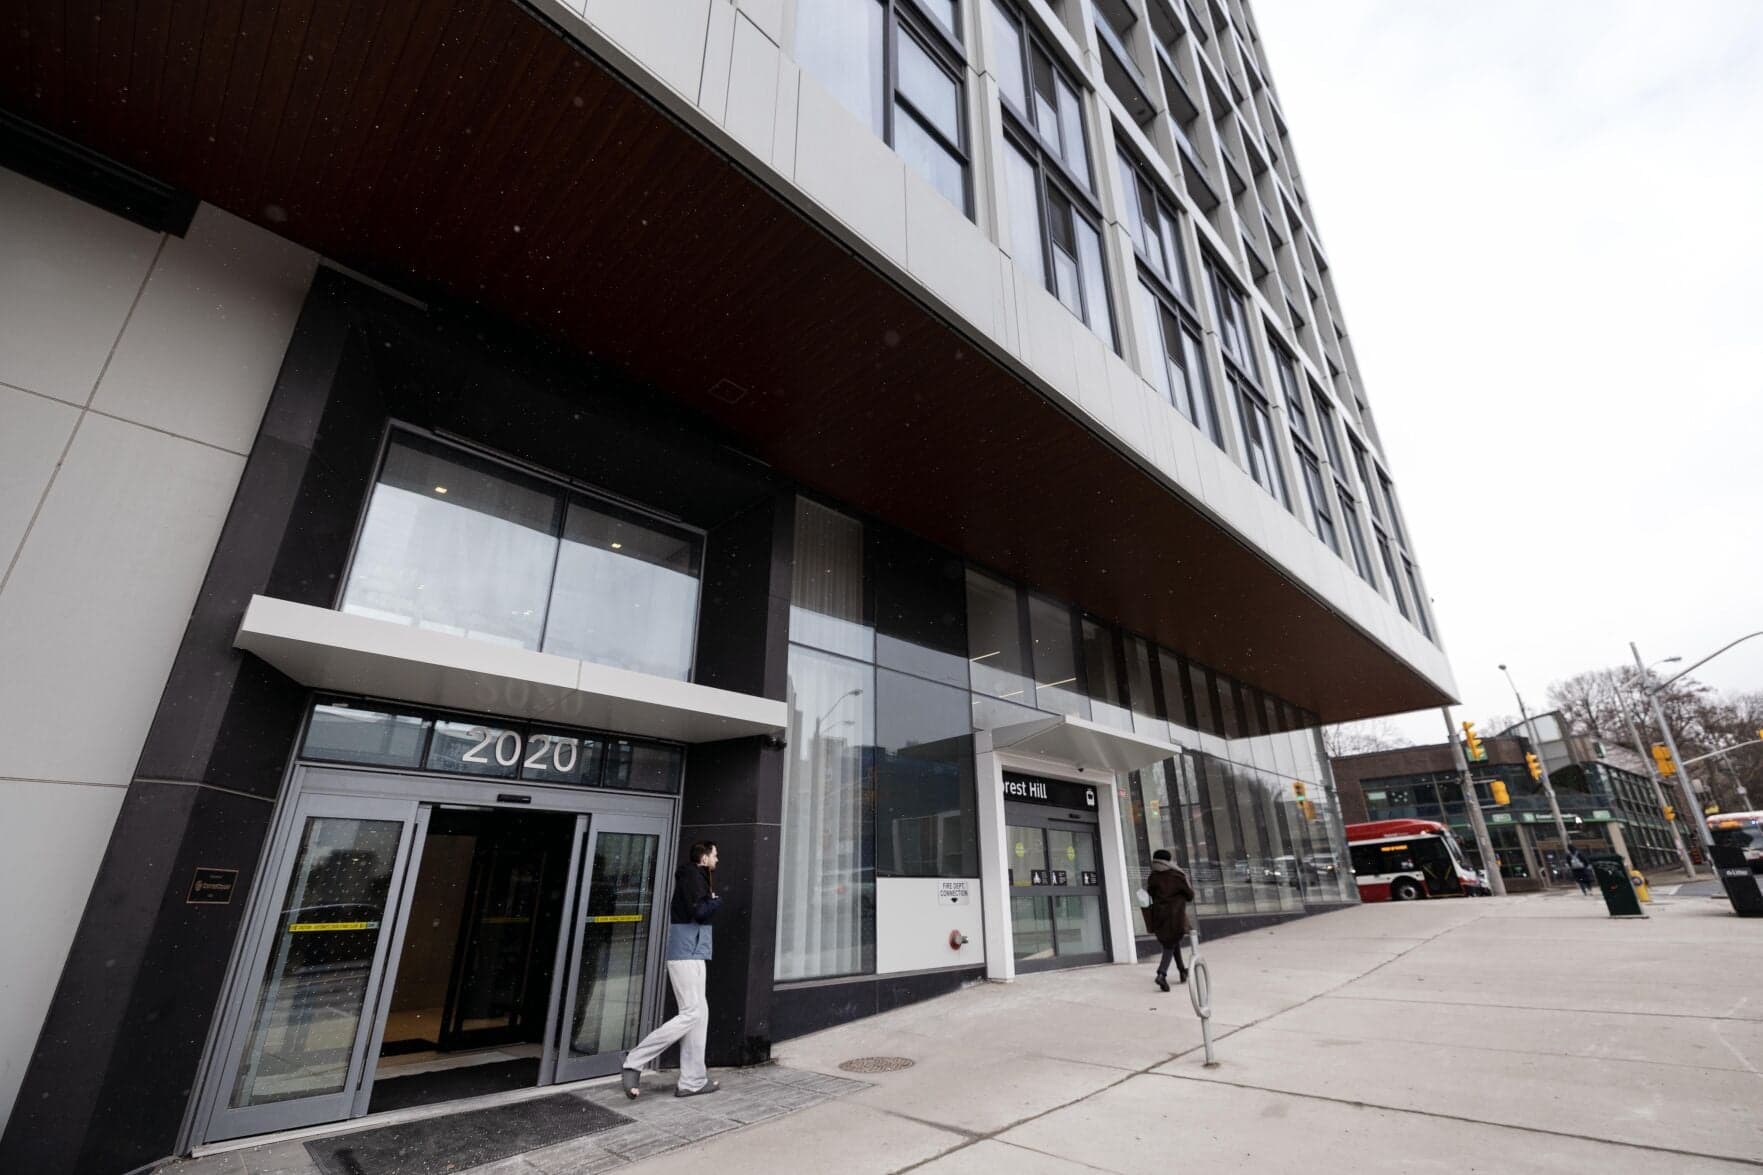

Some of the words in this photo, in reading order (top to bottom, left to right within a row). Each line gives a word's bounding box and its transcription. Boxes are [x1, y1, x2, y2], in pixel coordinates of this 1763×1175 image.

[462, 726, 578, 773] 2020
[1029, 782, 1047, 799] Hill
[942, 882, 952, 890] FIRE
